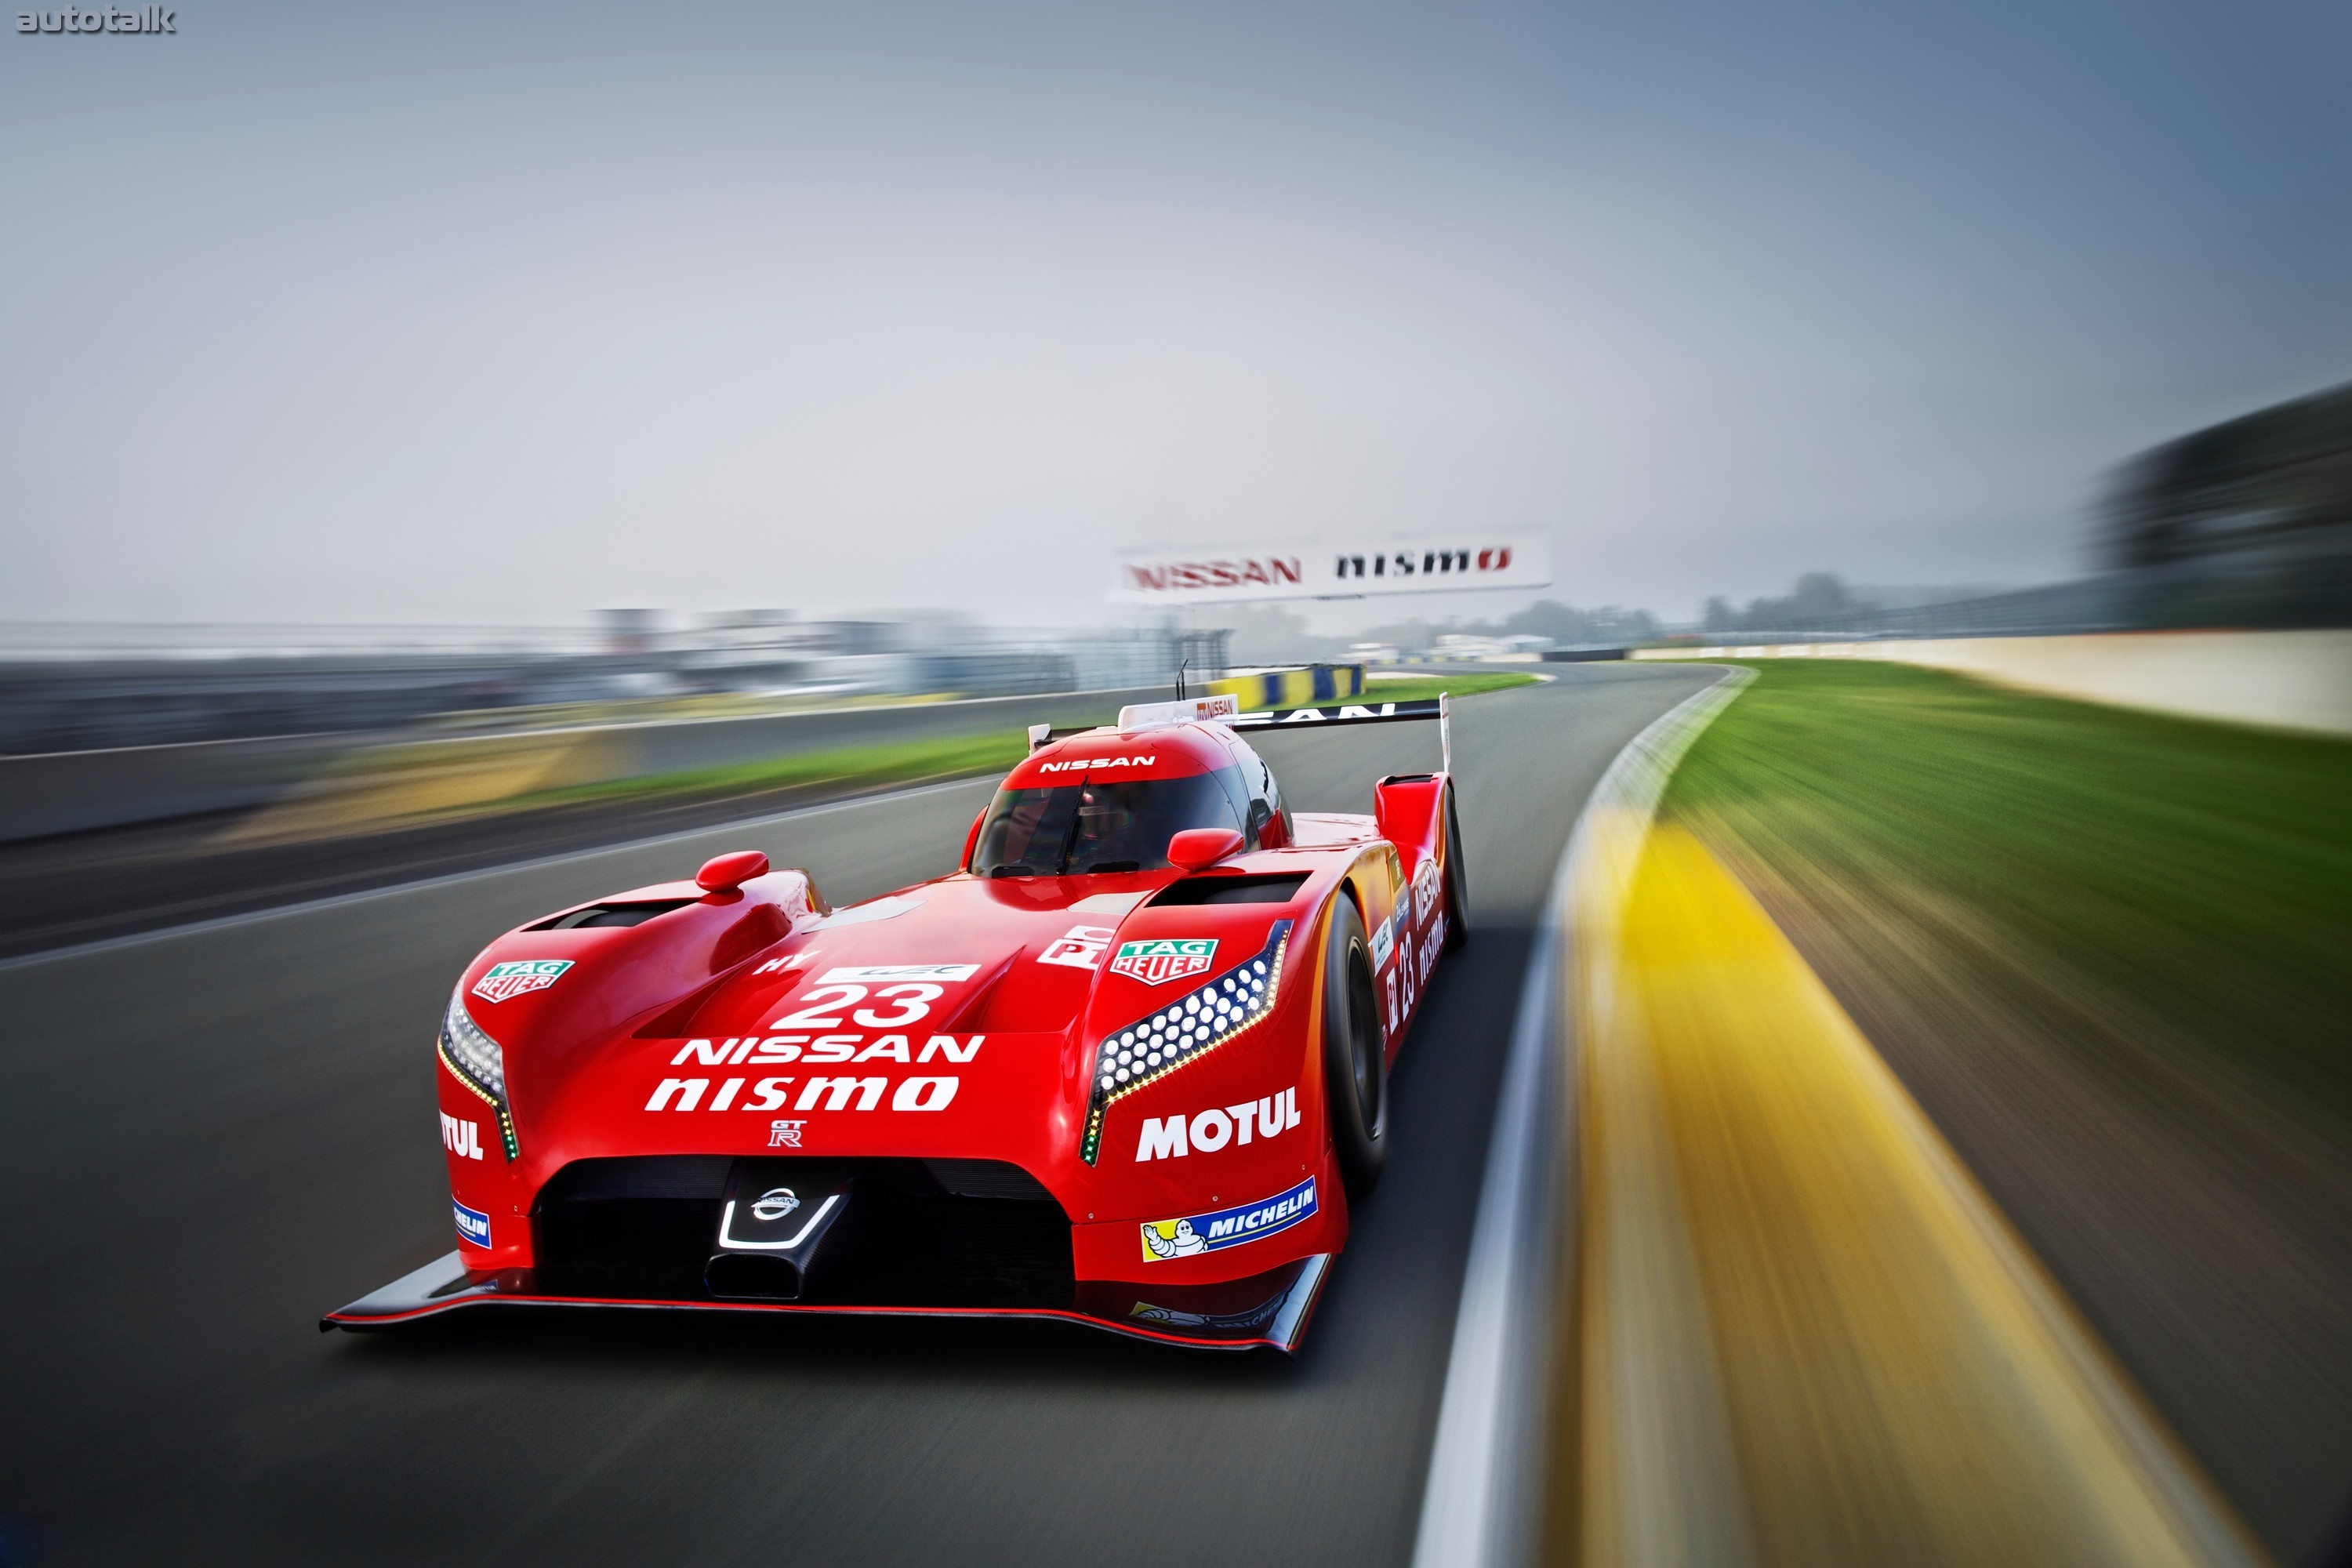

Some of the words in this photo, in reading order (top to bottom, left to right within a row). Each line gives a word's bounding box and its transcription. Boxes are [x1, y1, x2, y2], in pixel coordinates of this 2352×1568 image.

[1129, 556, 1301, 591] NISSAN
[1335, 546, 1512, 579] nismo
[1207, 699, 1233, 719] NISSAN
[1040, 755, 1156, 773] NISSAN
[1414, 862, 1441, 931] NISSAN
[1048, 943, 1106, 964] P1
[1129, 941, 1207, 955] TAG
[498, 962, 564, 976] TAG
[1116, 956, 1205, 981] HEUER
[1399, 931, 1414, 1022] 23
[477, 976, 551, 999] HEUER
[770, 983, 944, 1029] 23
[670, 1035, 985, 1065] NISSAN
[644, 1076, 960, 1112] nismo
[439, 1108, 484, 1160] TUL
[1135, 1086, 1301, 1162] MOTUL
[1208, 1185, 1315, 1239] MICHELIN
